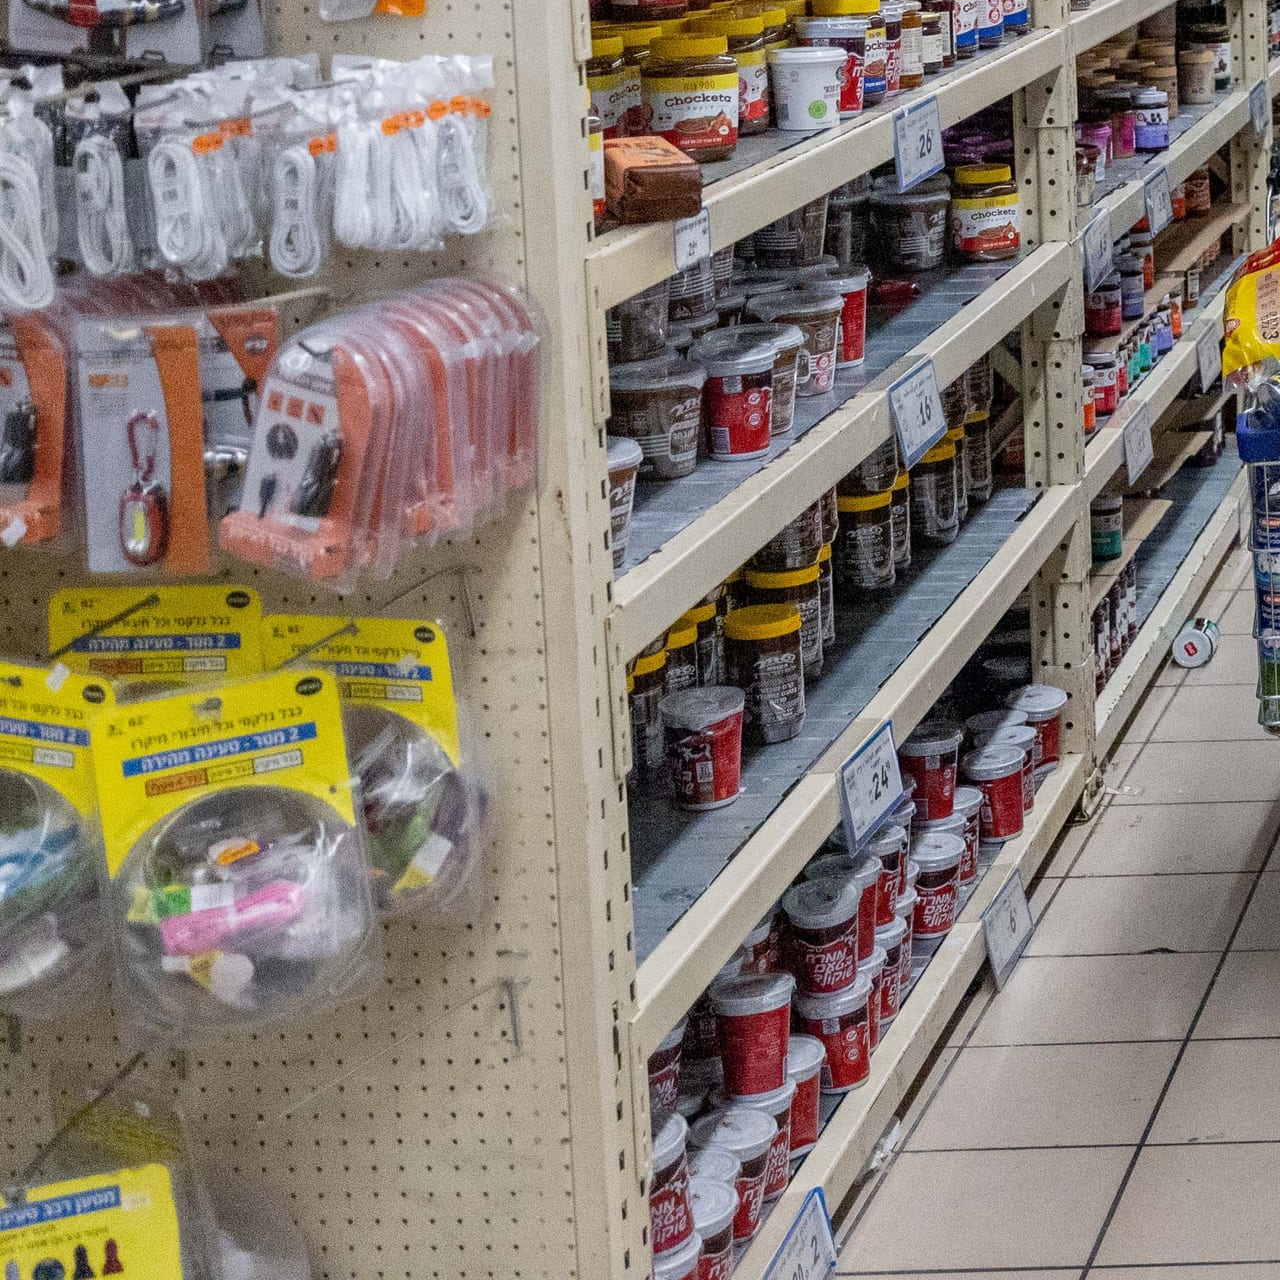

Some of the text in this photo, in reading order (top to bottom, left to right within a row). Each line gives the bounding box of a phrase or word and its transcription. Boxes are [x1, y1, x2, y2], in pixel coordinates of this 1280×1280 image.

[664, 92, 732, 108] Chocketa
[919, 129, 932, 159] 26
[919, 395, 932, 427] 16
[872, 764, 889, 801] 24
